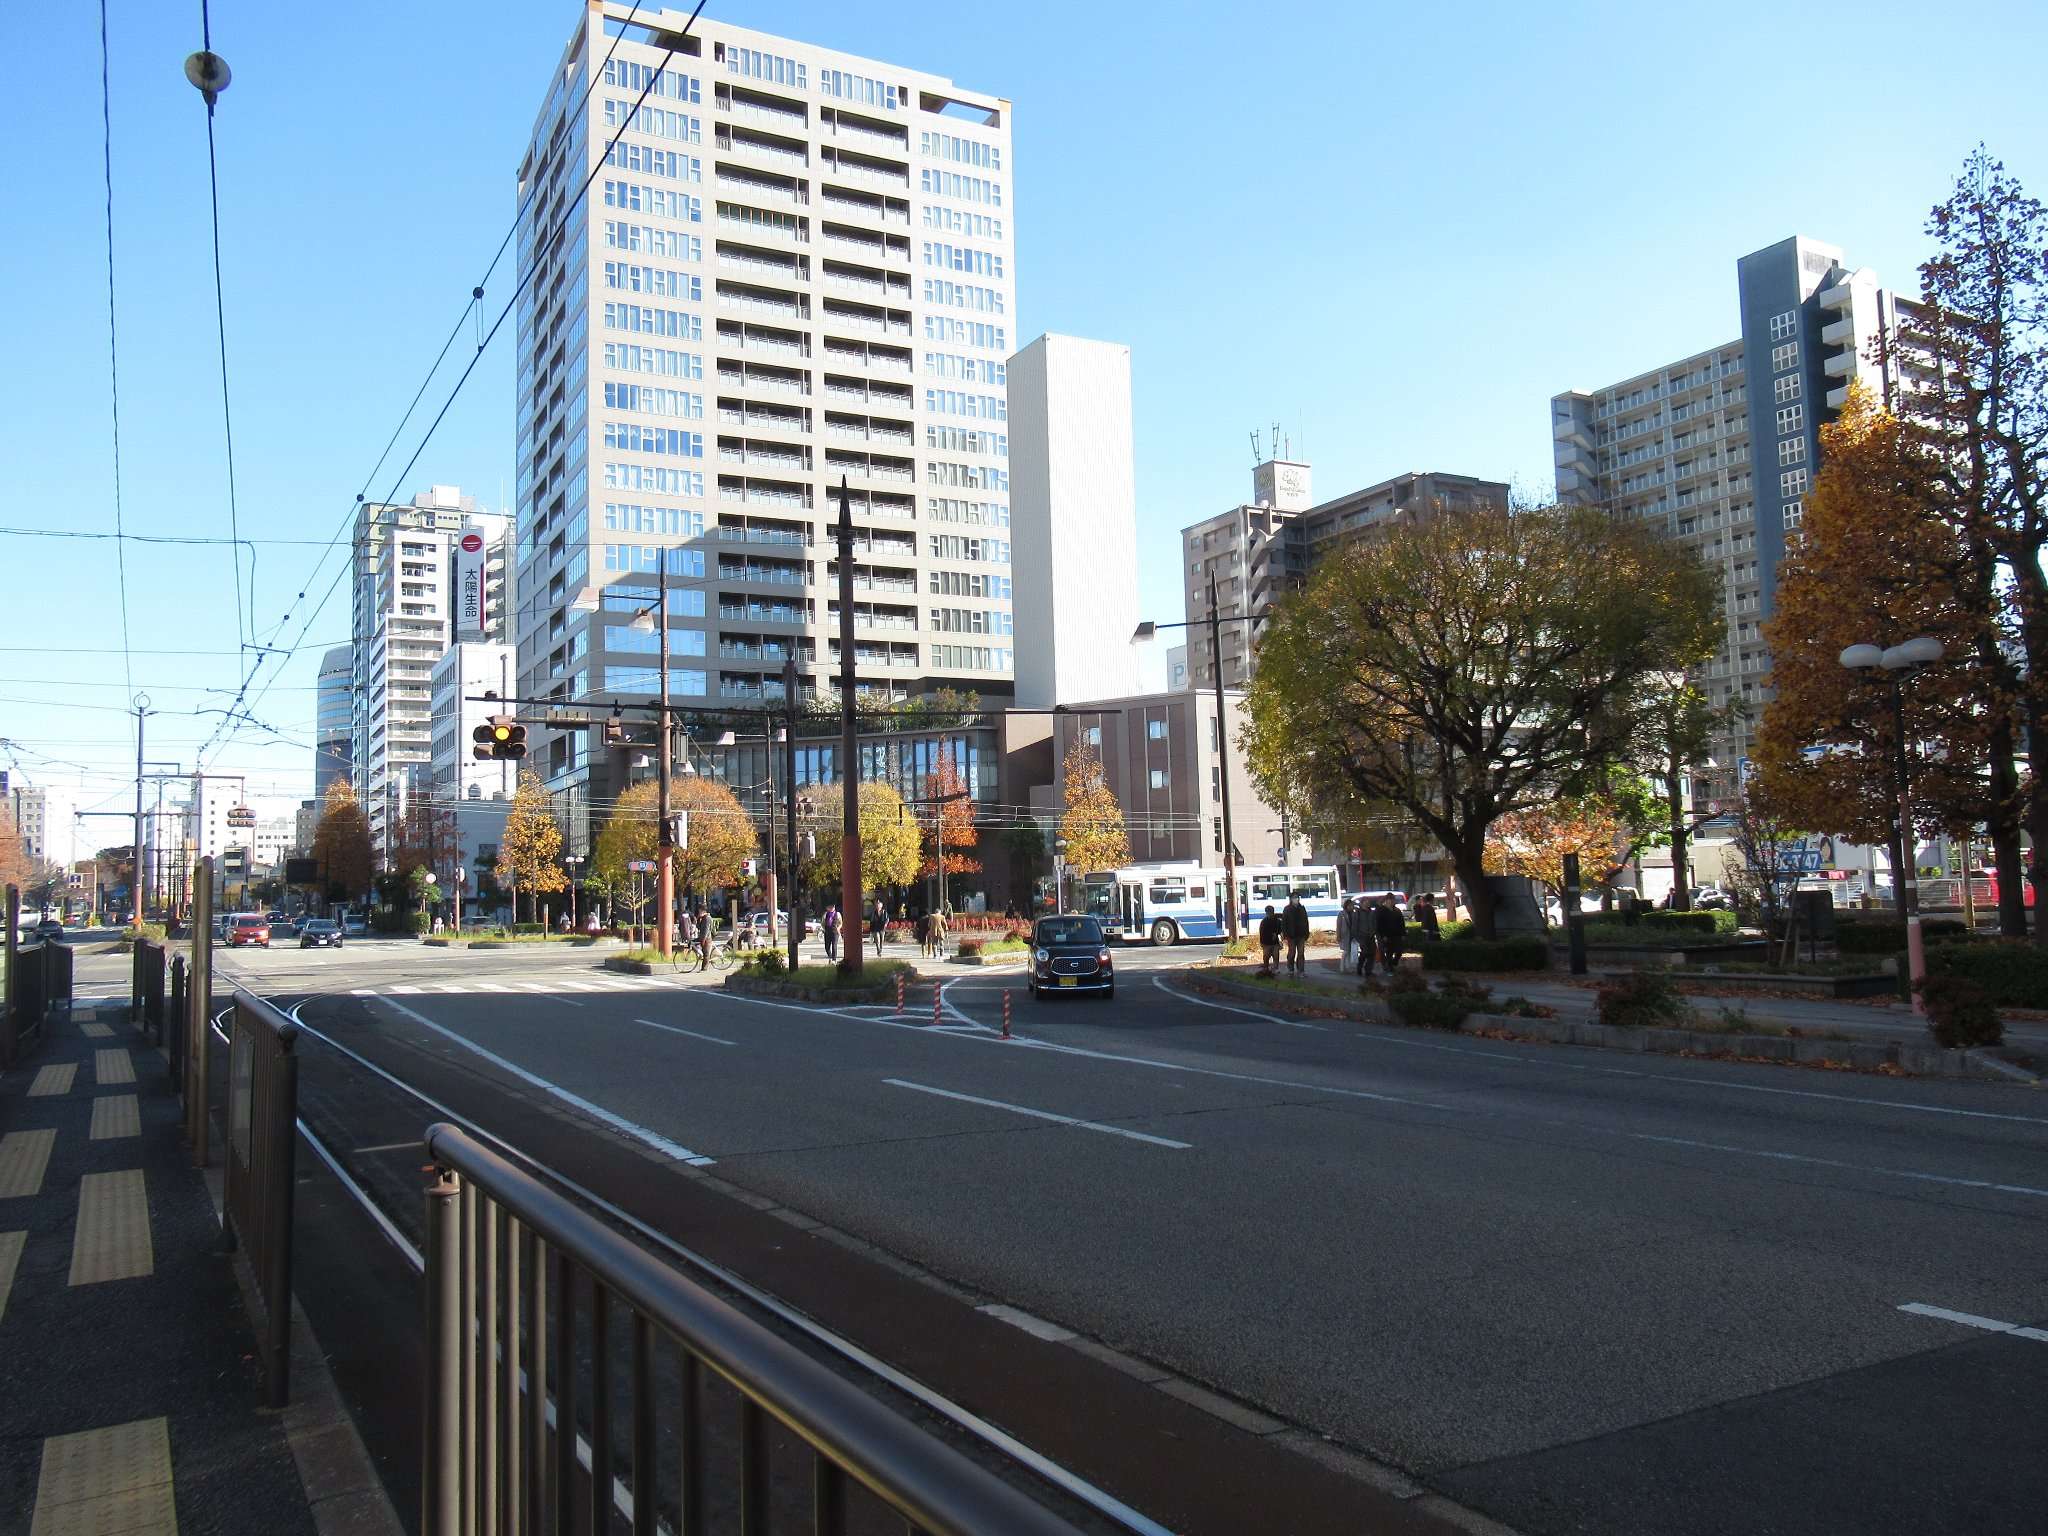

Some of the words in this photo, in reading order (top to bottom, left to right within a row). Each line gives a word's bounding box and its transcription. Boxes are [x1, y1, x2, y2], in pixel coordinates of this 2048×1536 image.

[465, 568, 478, 617] 太陽生命
[1173, 664, 1184, 685] P
